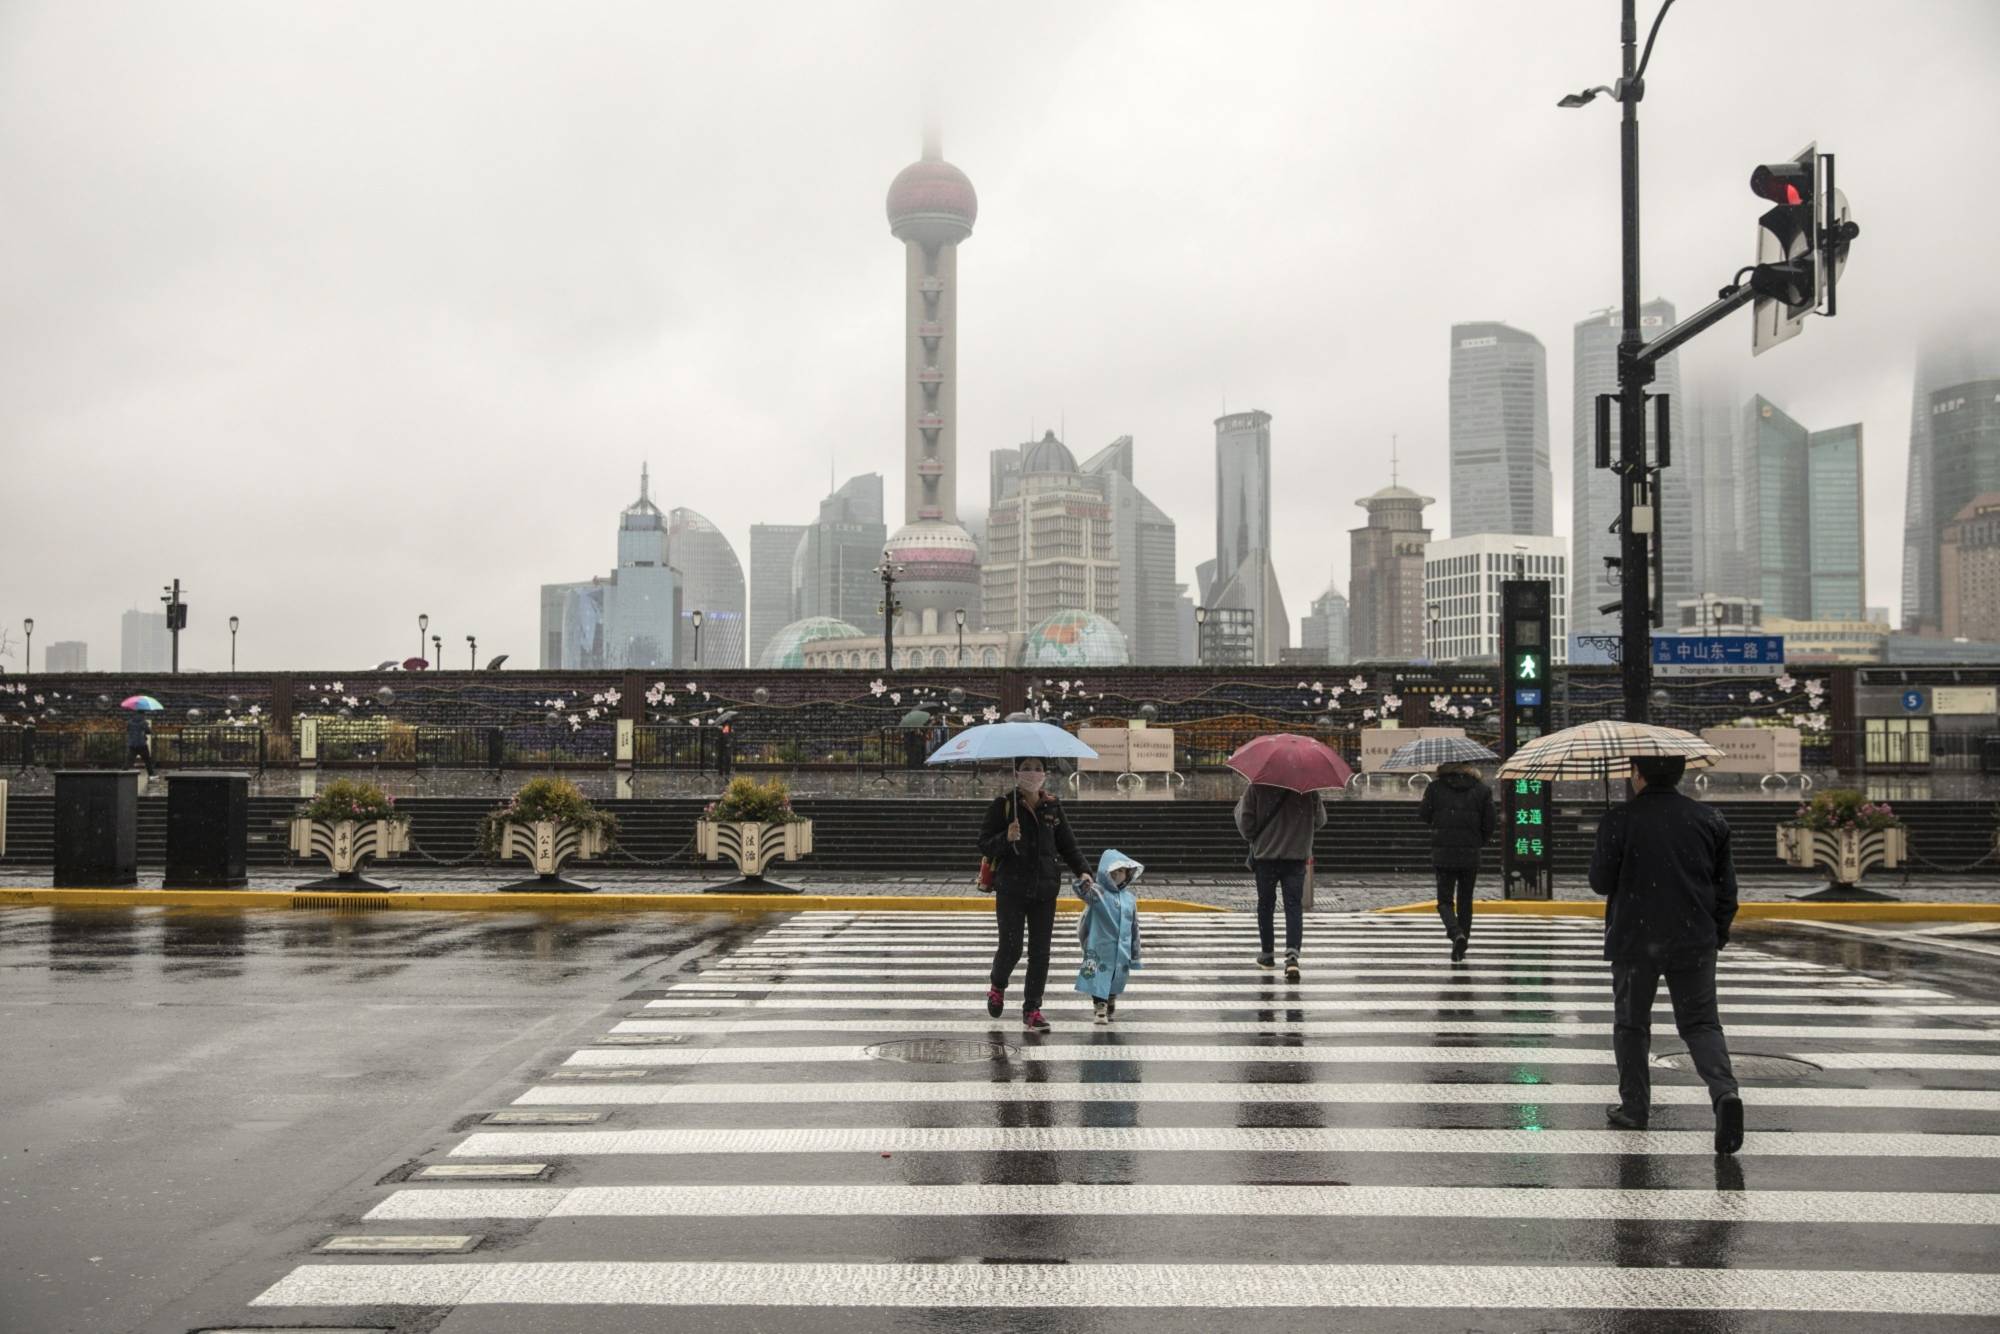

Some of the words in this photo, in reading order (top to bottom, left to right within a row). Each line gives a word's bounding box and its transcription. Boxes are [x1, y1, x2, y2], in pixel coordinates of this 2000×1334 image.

[1677, 642, 1758, 660] 中山东一路
[1680, 666, 1719, 676] Zhongshan
[1516, 809, 1542, 825] 交通
[540, 835, 551, 859] 公正
[745, 835, 756, 862] 法治
[1515, 838, 1544, 855] 信号
